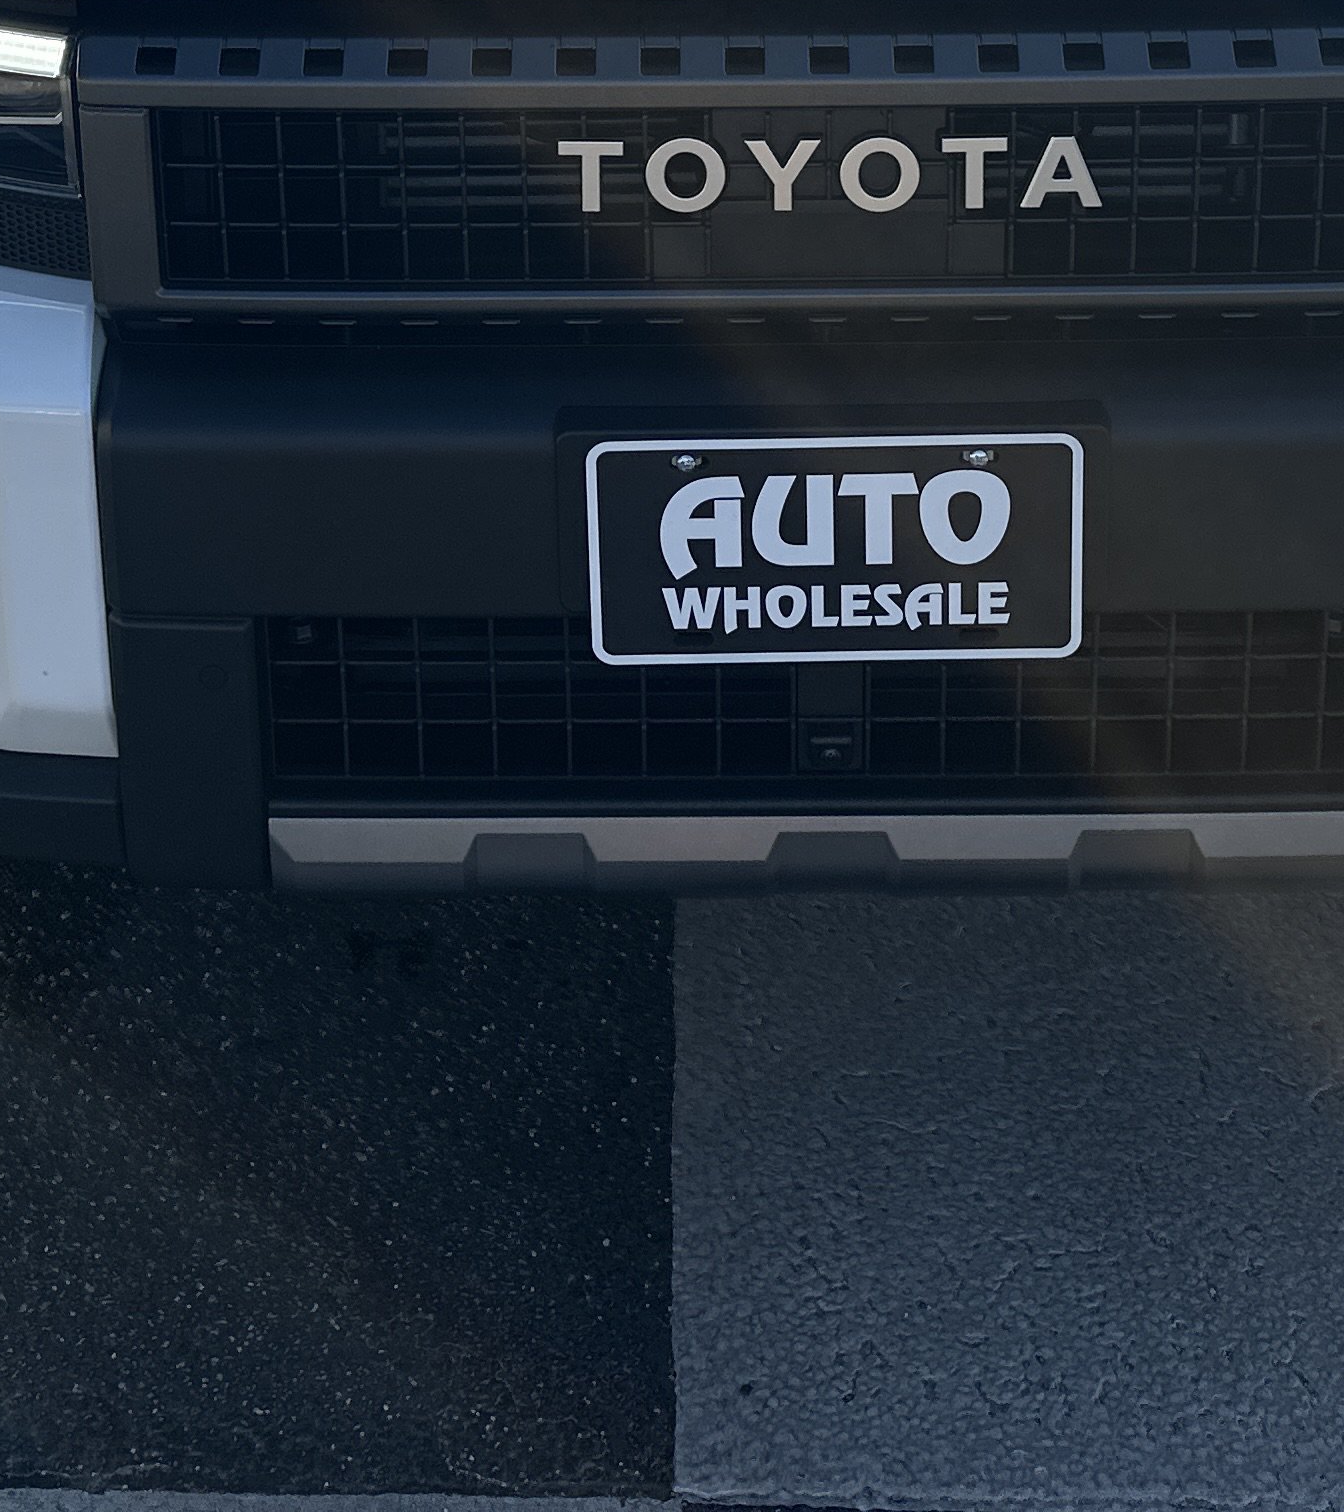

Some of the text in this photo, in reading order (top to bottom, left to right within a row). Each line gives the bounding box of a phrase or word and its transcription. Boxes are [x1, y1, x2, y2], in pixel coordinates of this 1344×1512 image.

[557, 135, 1103, 214] TOYOTA
[658, 468, 1013, 580] AUTO
[661, 580, 1012, 634] WHOLESALE
